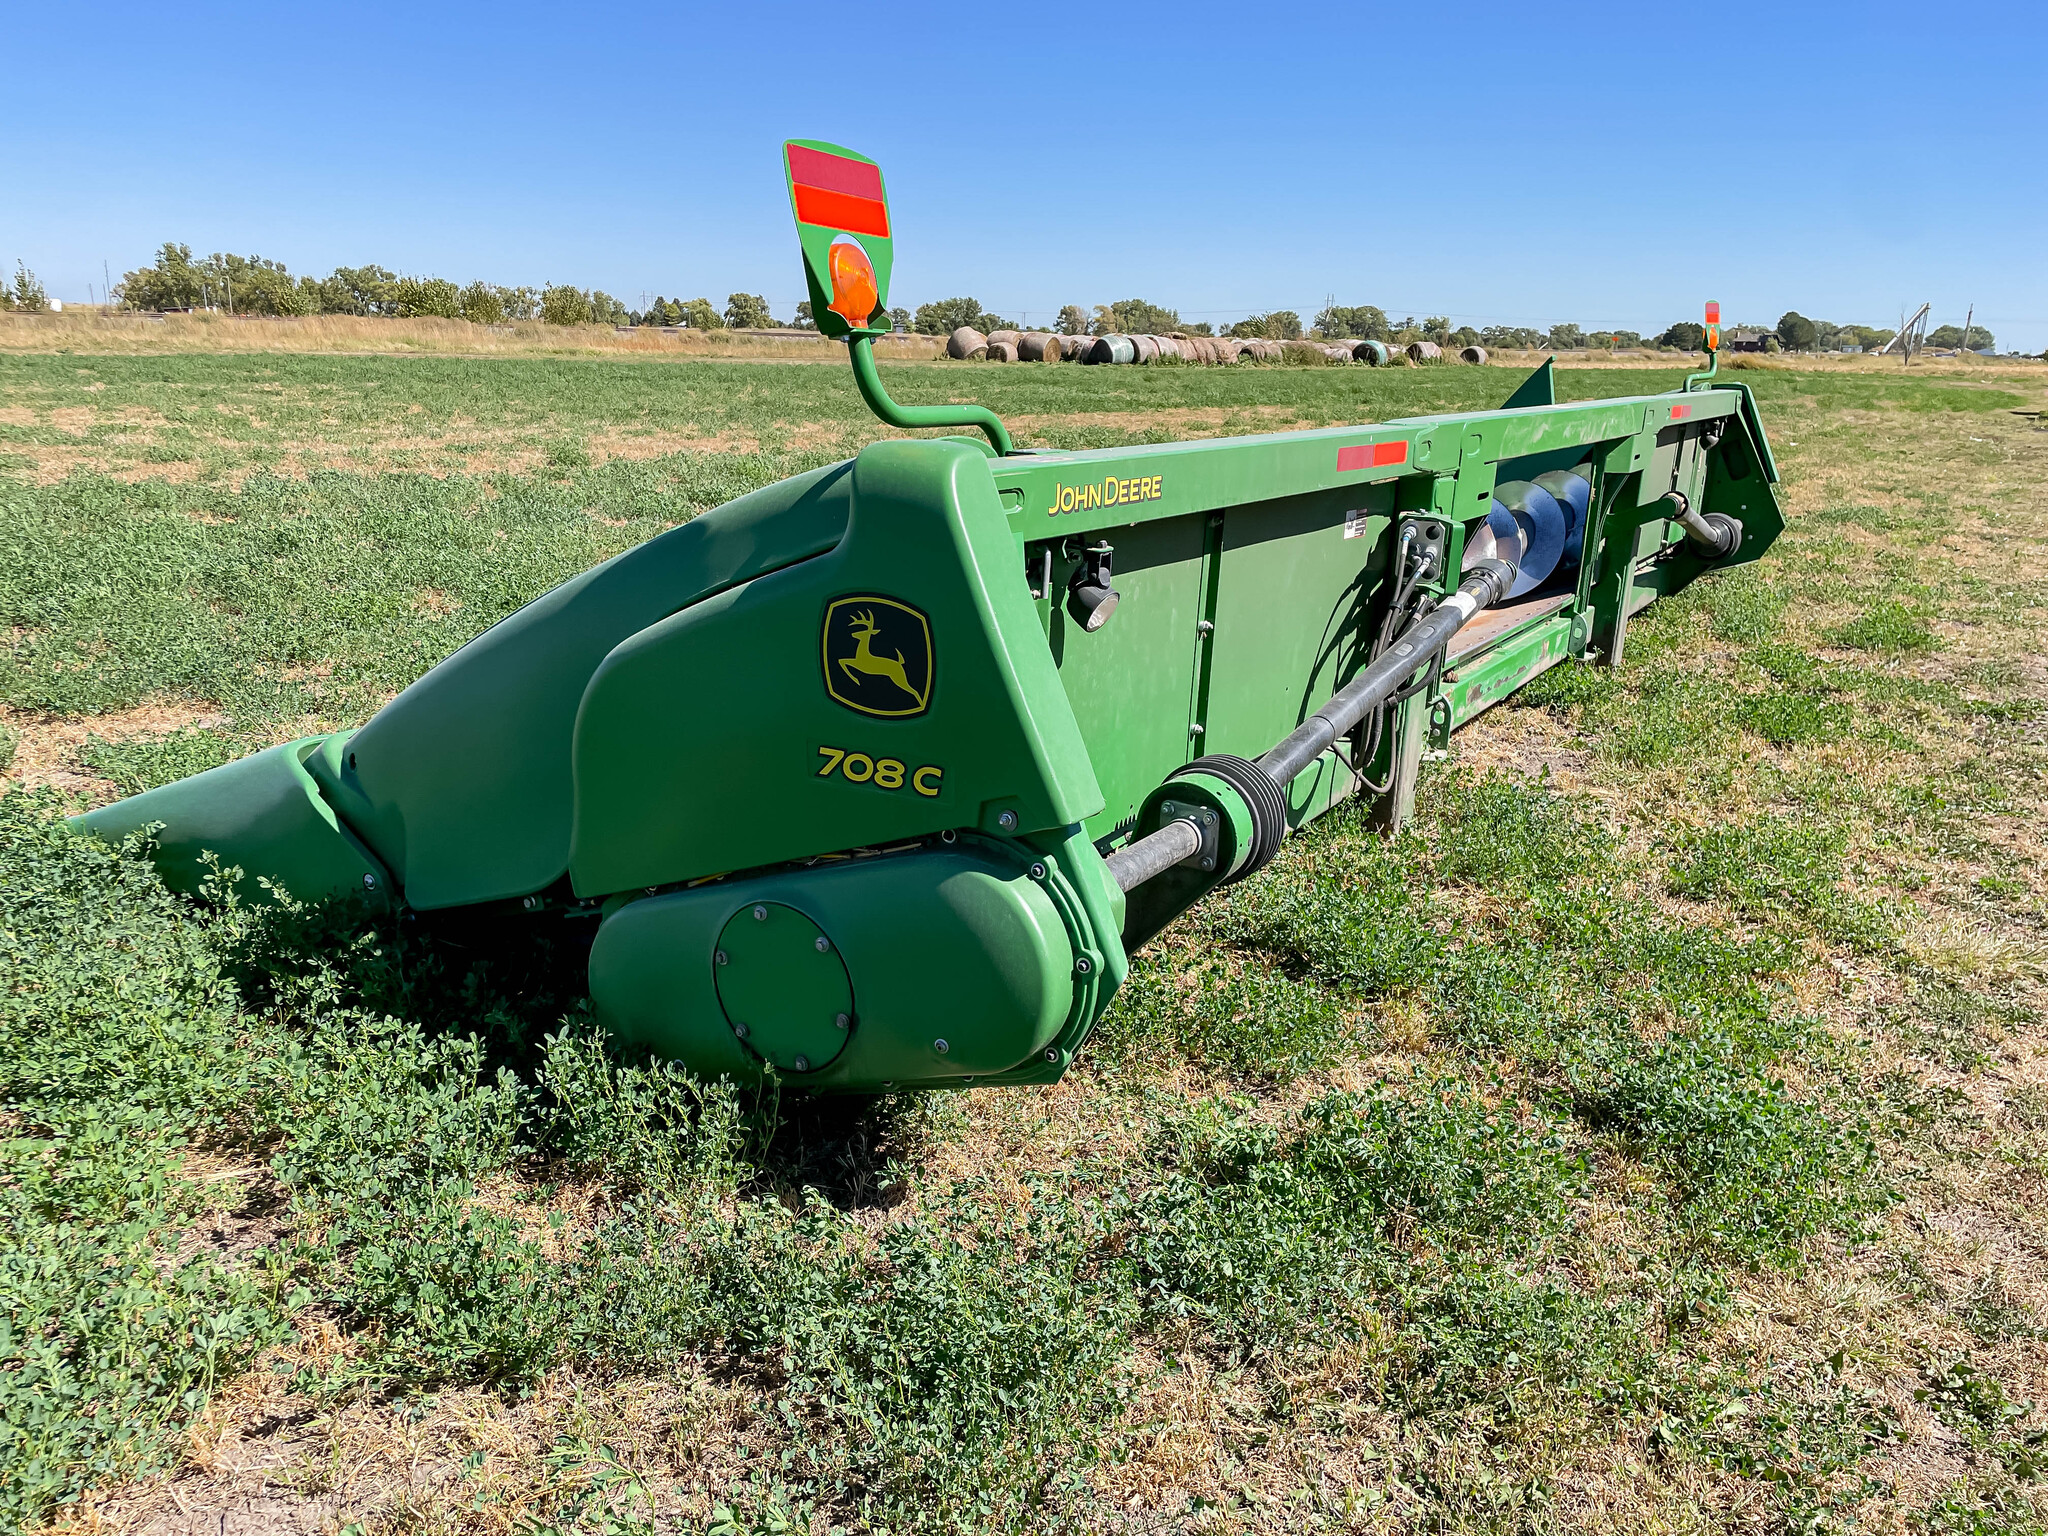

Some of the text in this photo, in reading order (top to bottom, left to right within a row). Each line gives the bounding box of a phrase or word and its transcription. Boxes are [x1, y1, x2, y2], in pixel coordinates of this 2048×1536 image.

[1048, 475, 1162, 516] JOHN DEERE
[816, 745, 943, 797] 708 C
